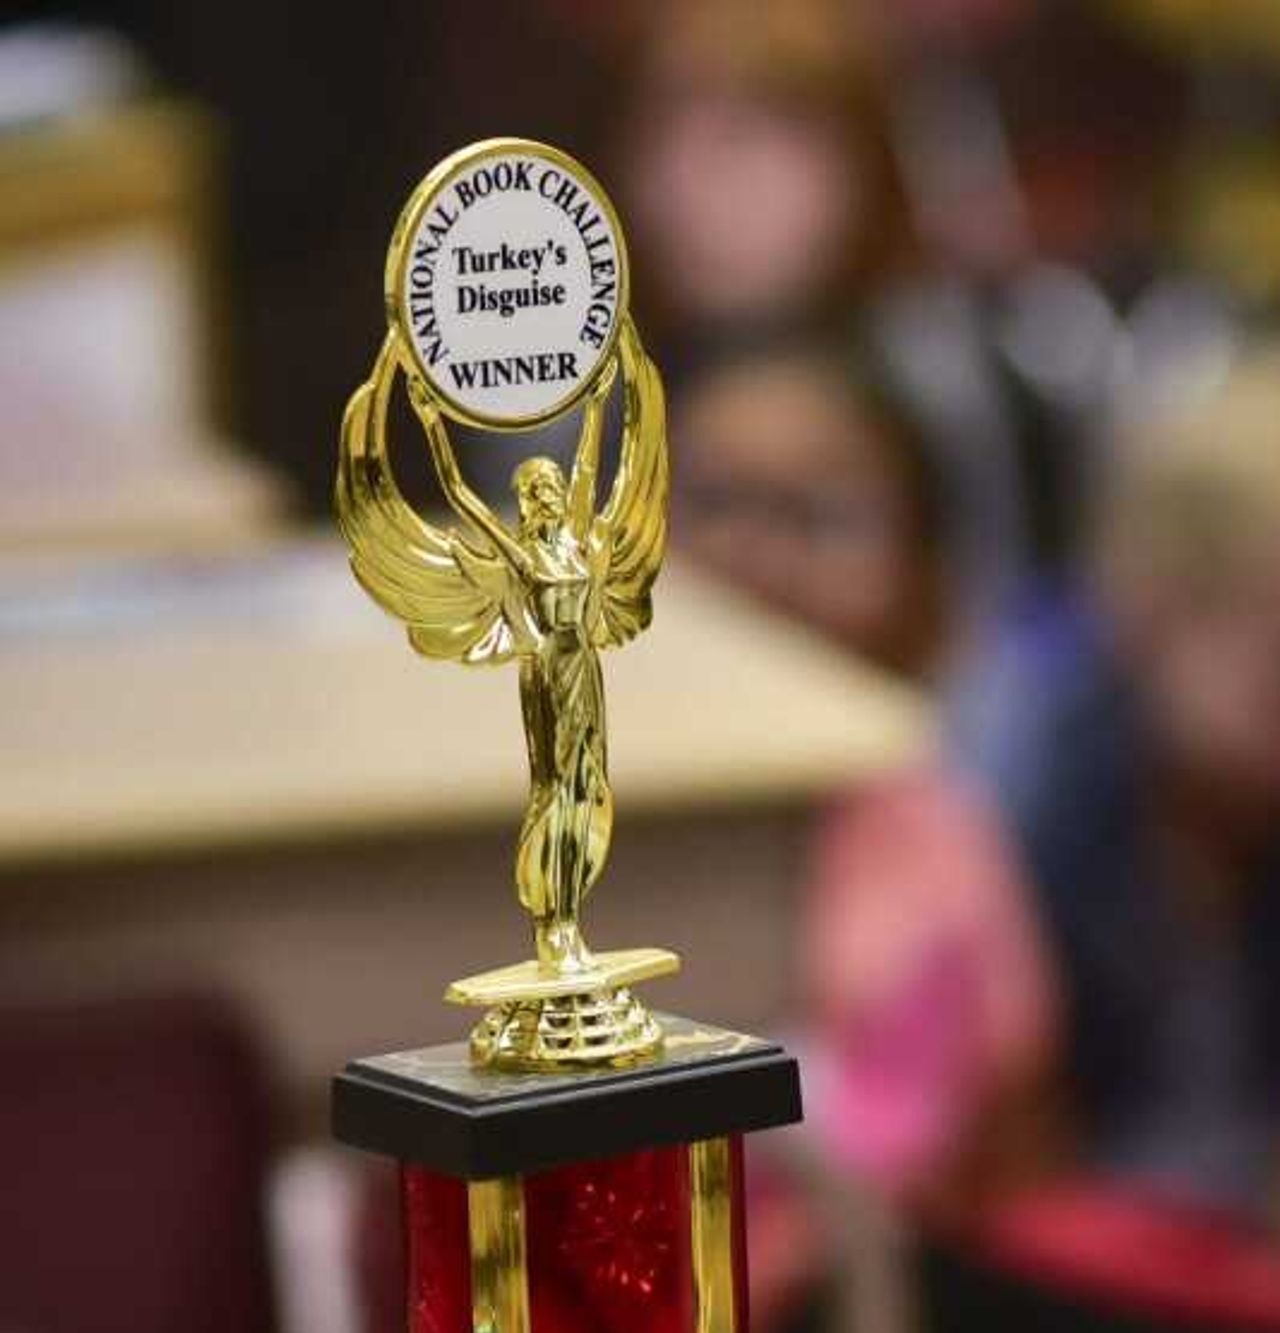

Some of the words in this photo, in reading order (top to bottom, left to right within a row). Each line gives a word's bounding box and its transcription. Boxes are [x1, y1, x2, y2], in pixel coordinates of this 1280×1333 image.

[409, 204, 459, 366] NATIONAL
[454, 161, 535, 209] BOOK
[538, 169, 616, 350] CHALLENGE
[452, 240, 567, 275] Turkey's
[456, 281, 566, 317] Disguise
[450, 352, 579, 390] WINNER
